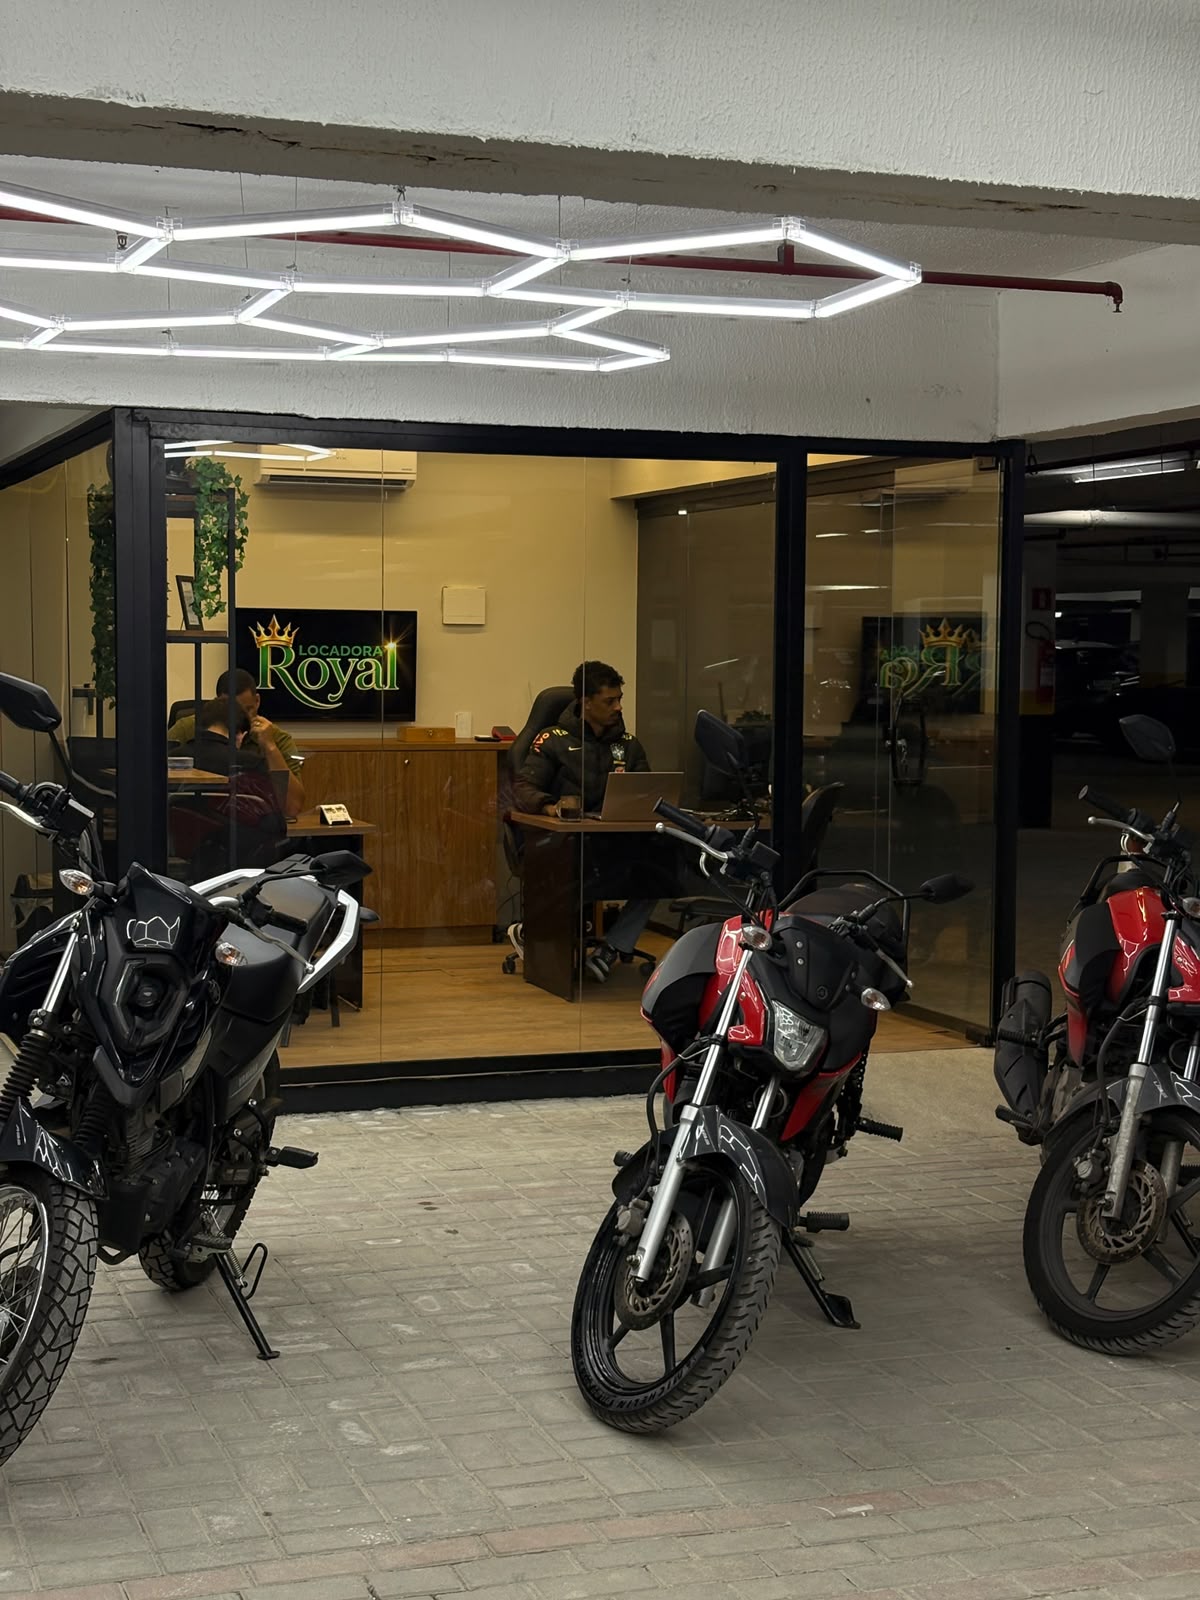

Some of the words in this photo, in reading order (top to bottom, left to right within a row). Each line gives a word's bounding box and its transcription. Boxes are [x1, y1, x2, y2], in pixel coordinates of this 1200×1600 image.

[299, 645, 383, 657] LOCADORA
[256, 643, 400, 710] Royal
[616, 1369, 683, 1409] MICHELIN
